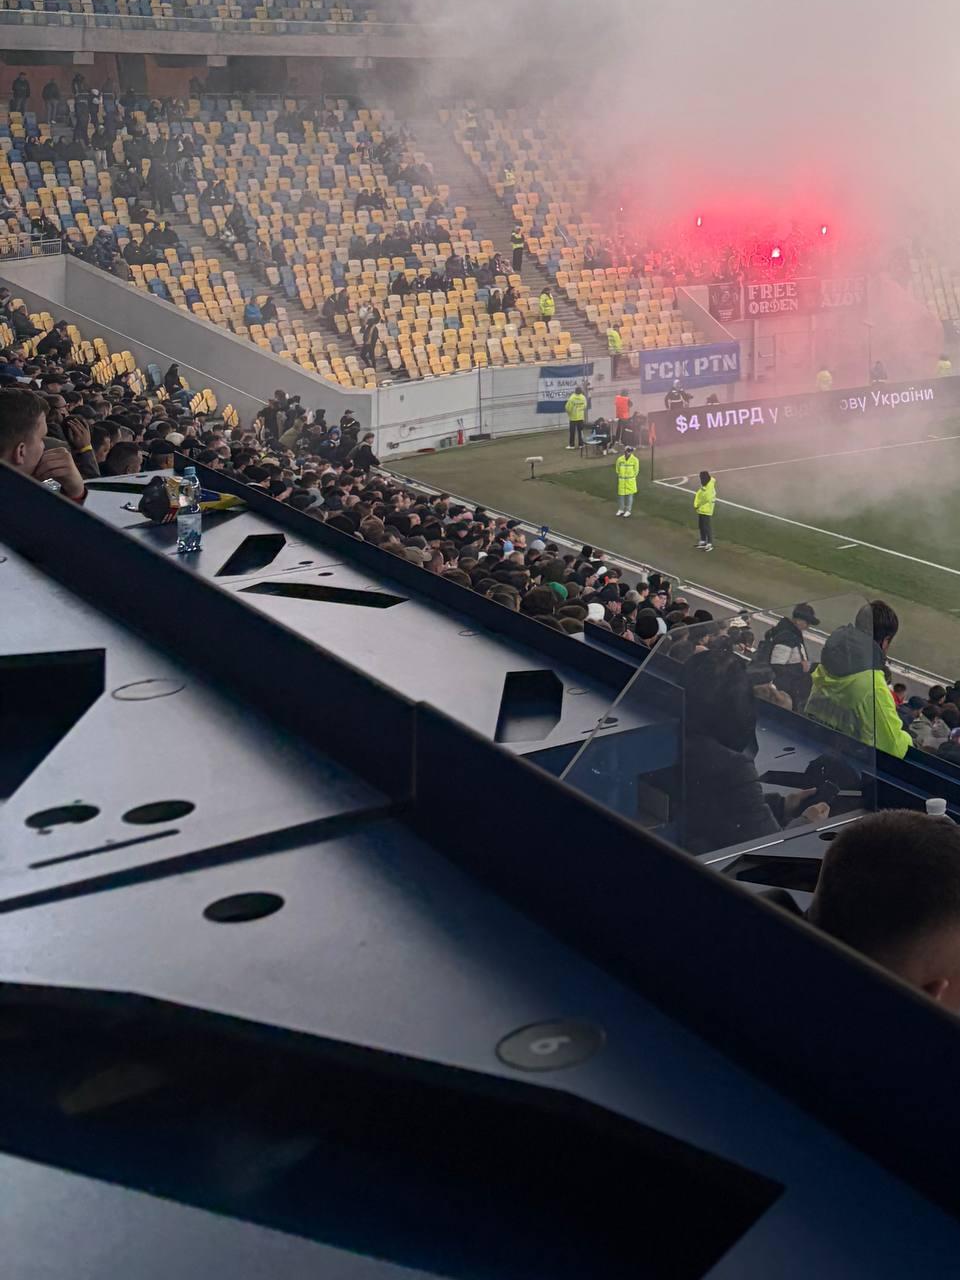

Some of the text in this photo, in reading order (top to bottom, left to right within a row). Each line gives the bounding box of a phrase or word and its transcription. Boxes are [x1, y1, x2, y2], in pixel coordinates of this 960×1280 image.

[748, 282, 798, 300] FREE
[644, 352, 737, 382] FCK PTN
[871, 387, 934, 409] України
[675, 414, 701, 434] $4
[707, 407, 764, 429] МЛРД
[769, 407, 779, 424] у
